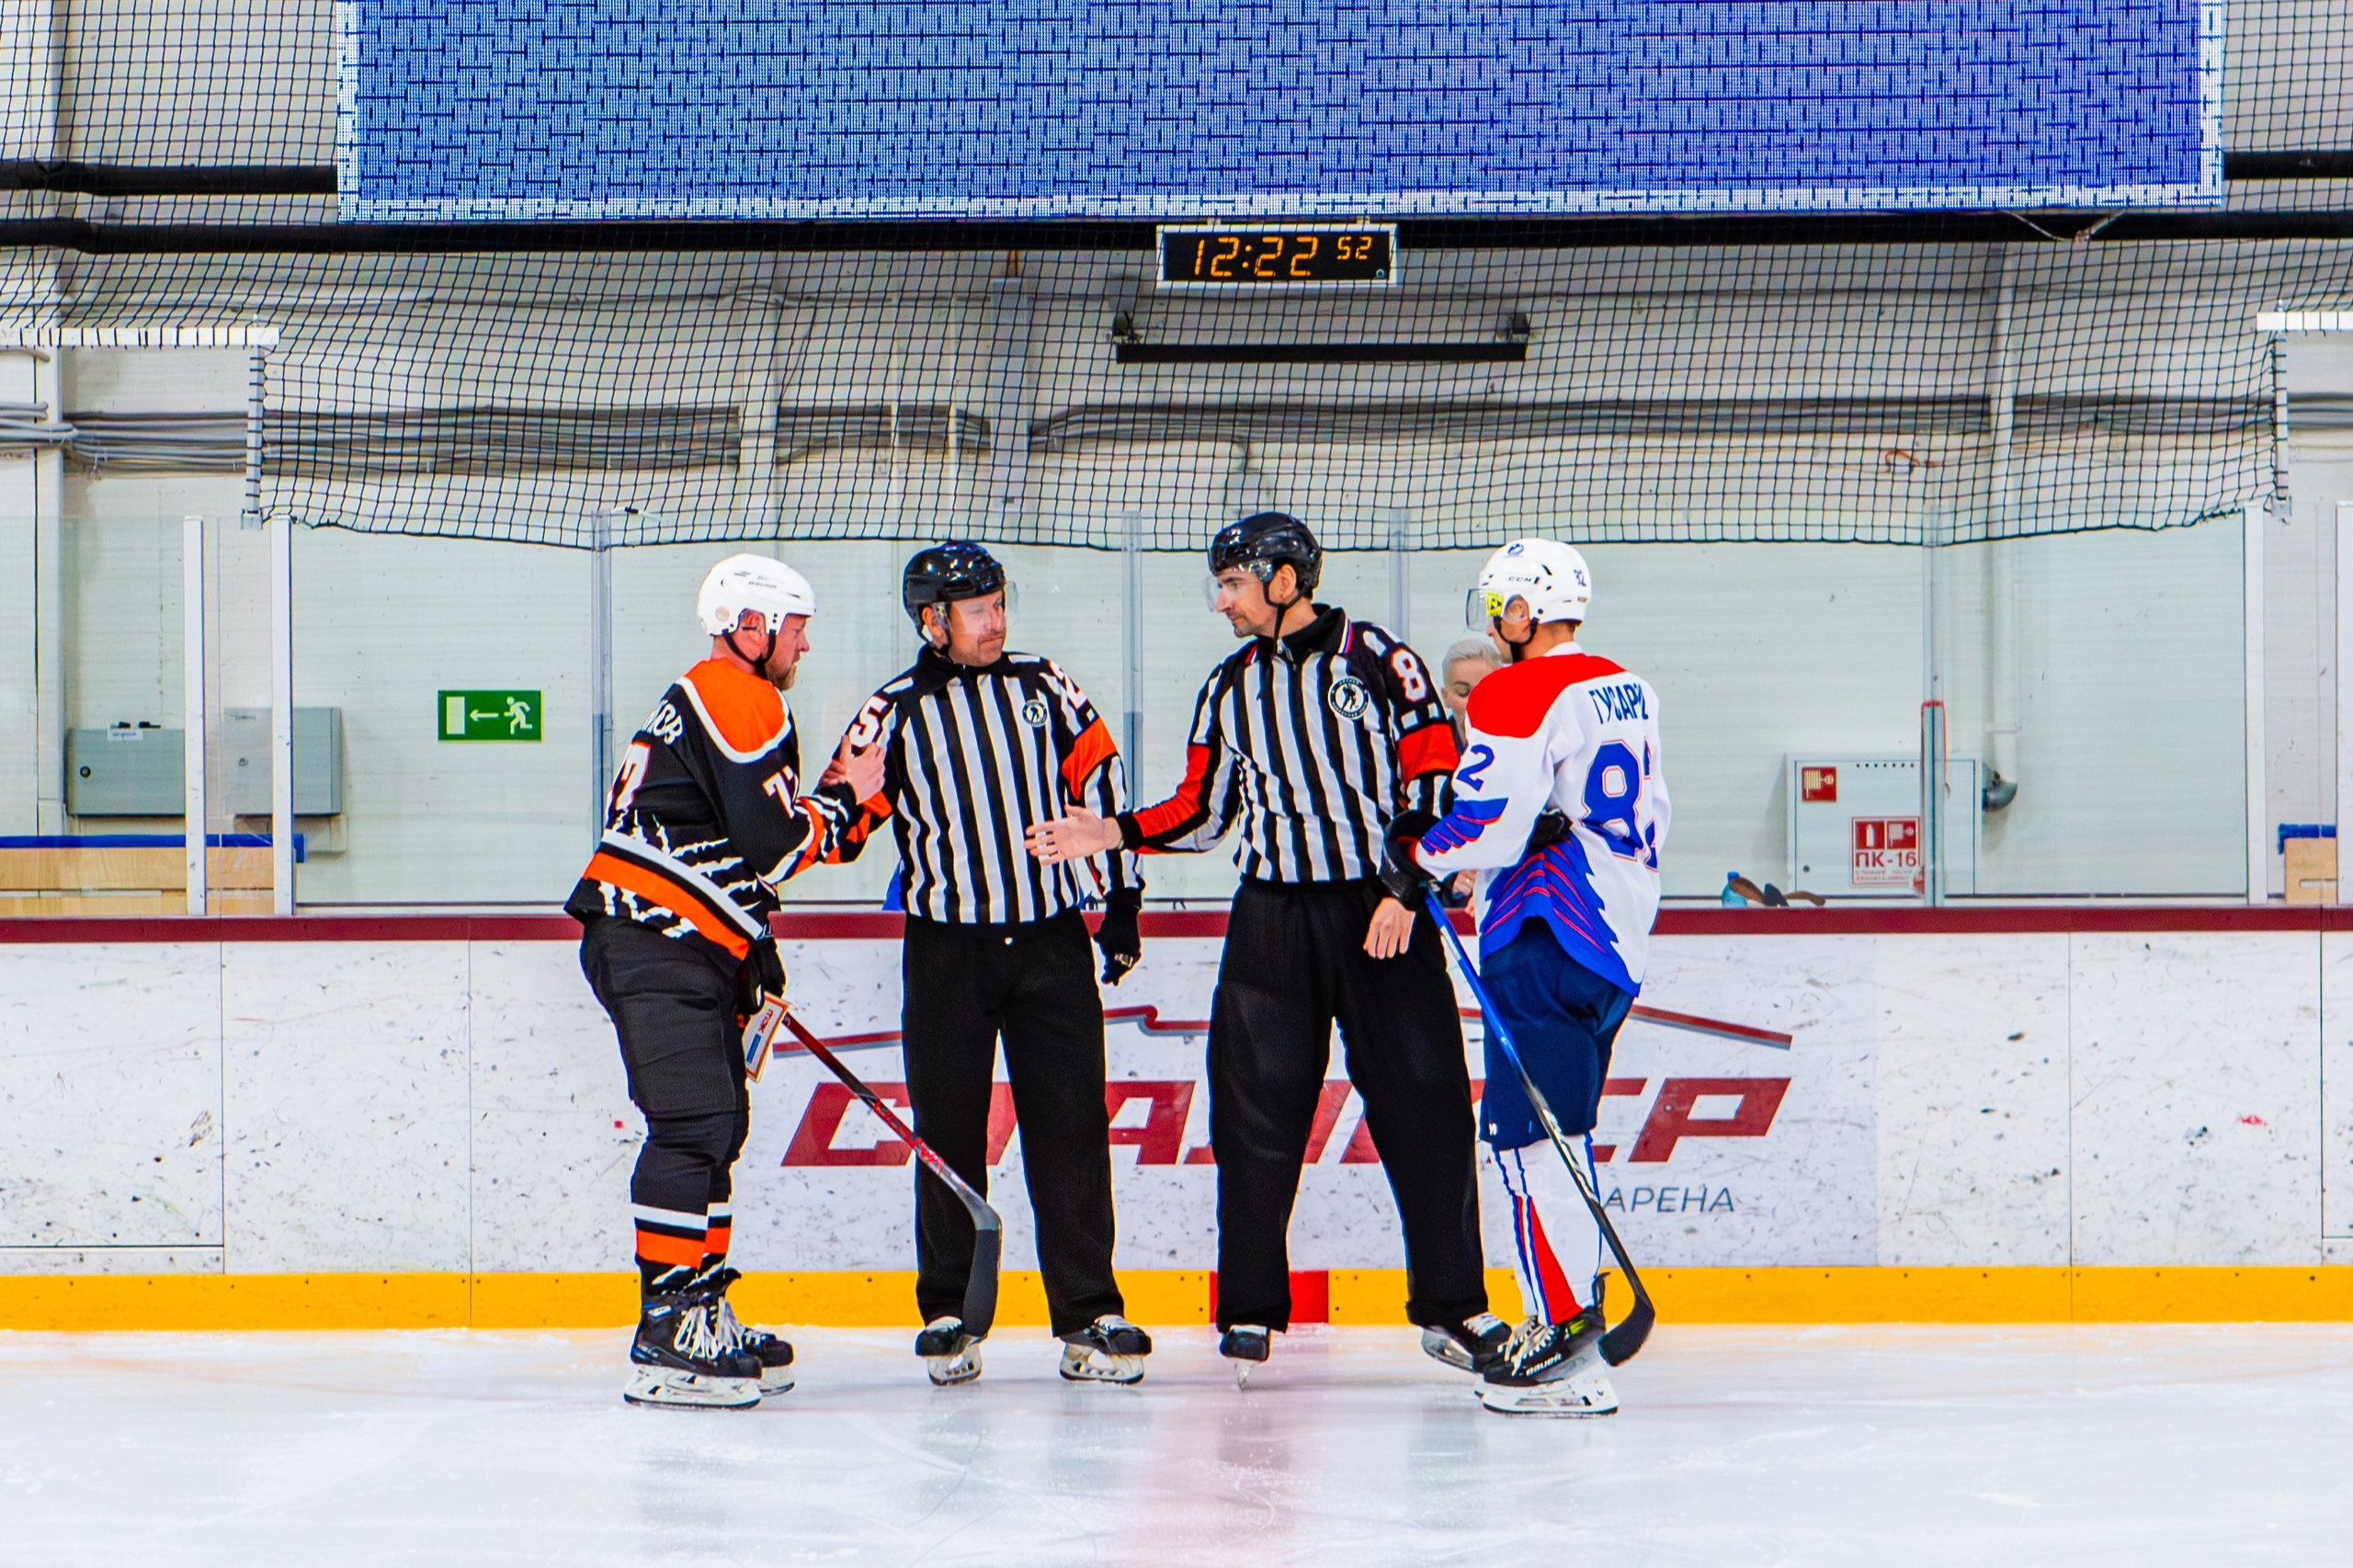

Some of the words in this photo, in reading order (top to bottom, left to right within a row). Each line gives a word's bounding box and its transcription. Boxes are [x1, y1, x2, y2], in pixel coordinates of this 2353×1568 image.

[1194, 236, 1319, 277] 12:22
[1336, 236, 1372, 259] 52
[1391, 647, 1427, 702] 8
[1456, 744, 1495, 792] 2
[1855, 851, 1917, 868] ПК-16
[1603, 1187, 1734, 1212] АРЕНА
